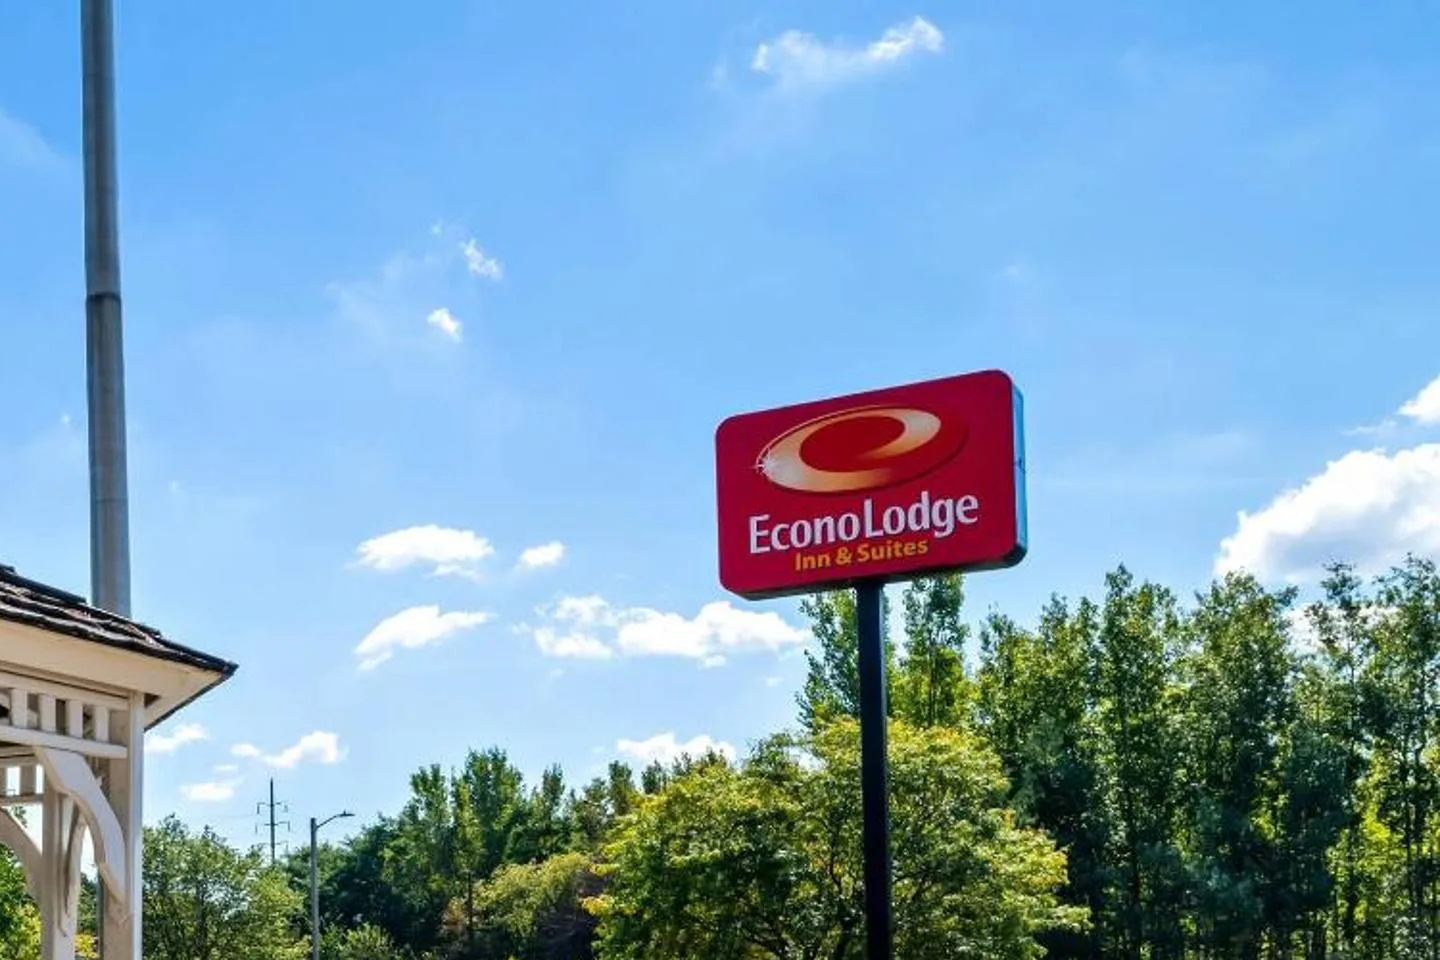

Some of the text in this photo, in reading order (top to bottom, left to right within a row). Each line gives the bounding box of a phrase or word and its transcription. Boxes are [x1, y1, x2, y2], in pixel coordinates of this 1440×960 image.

[794, 539, 929, 571] Inn & Suites
